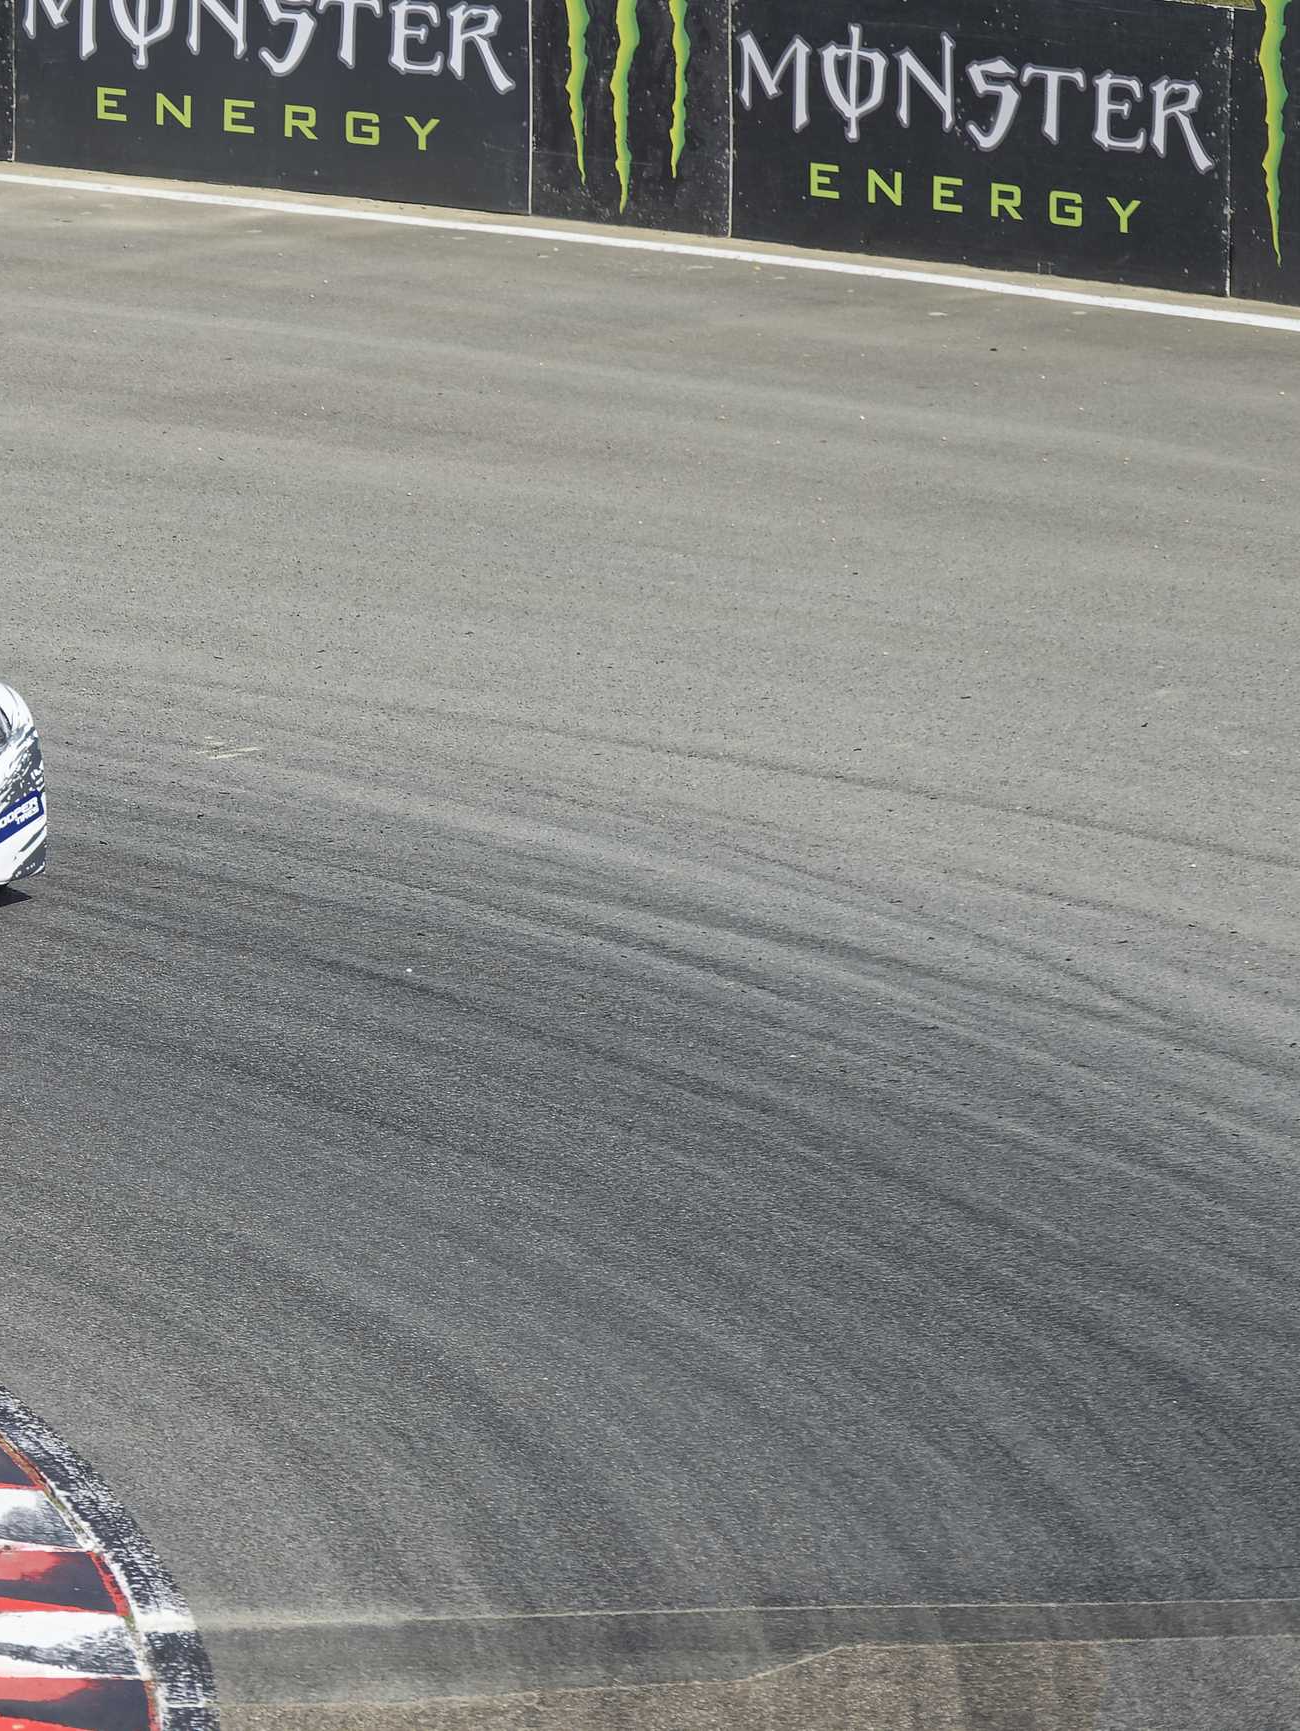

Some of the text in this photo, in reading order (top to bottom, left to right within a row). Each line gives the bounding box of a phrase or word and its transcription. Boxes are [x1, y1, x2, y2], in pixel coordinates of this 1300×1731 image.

[95, 86, 440, 151] ENERGY
[736, 22, 1215, 174] MONSTER
[809, 162, 1141, 234] ENERGY
